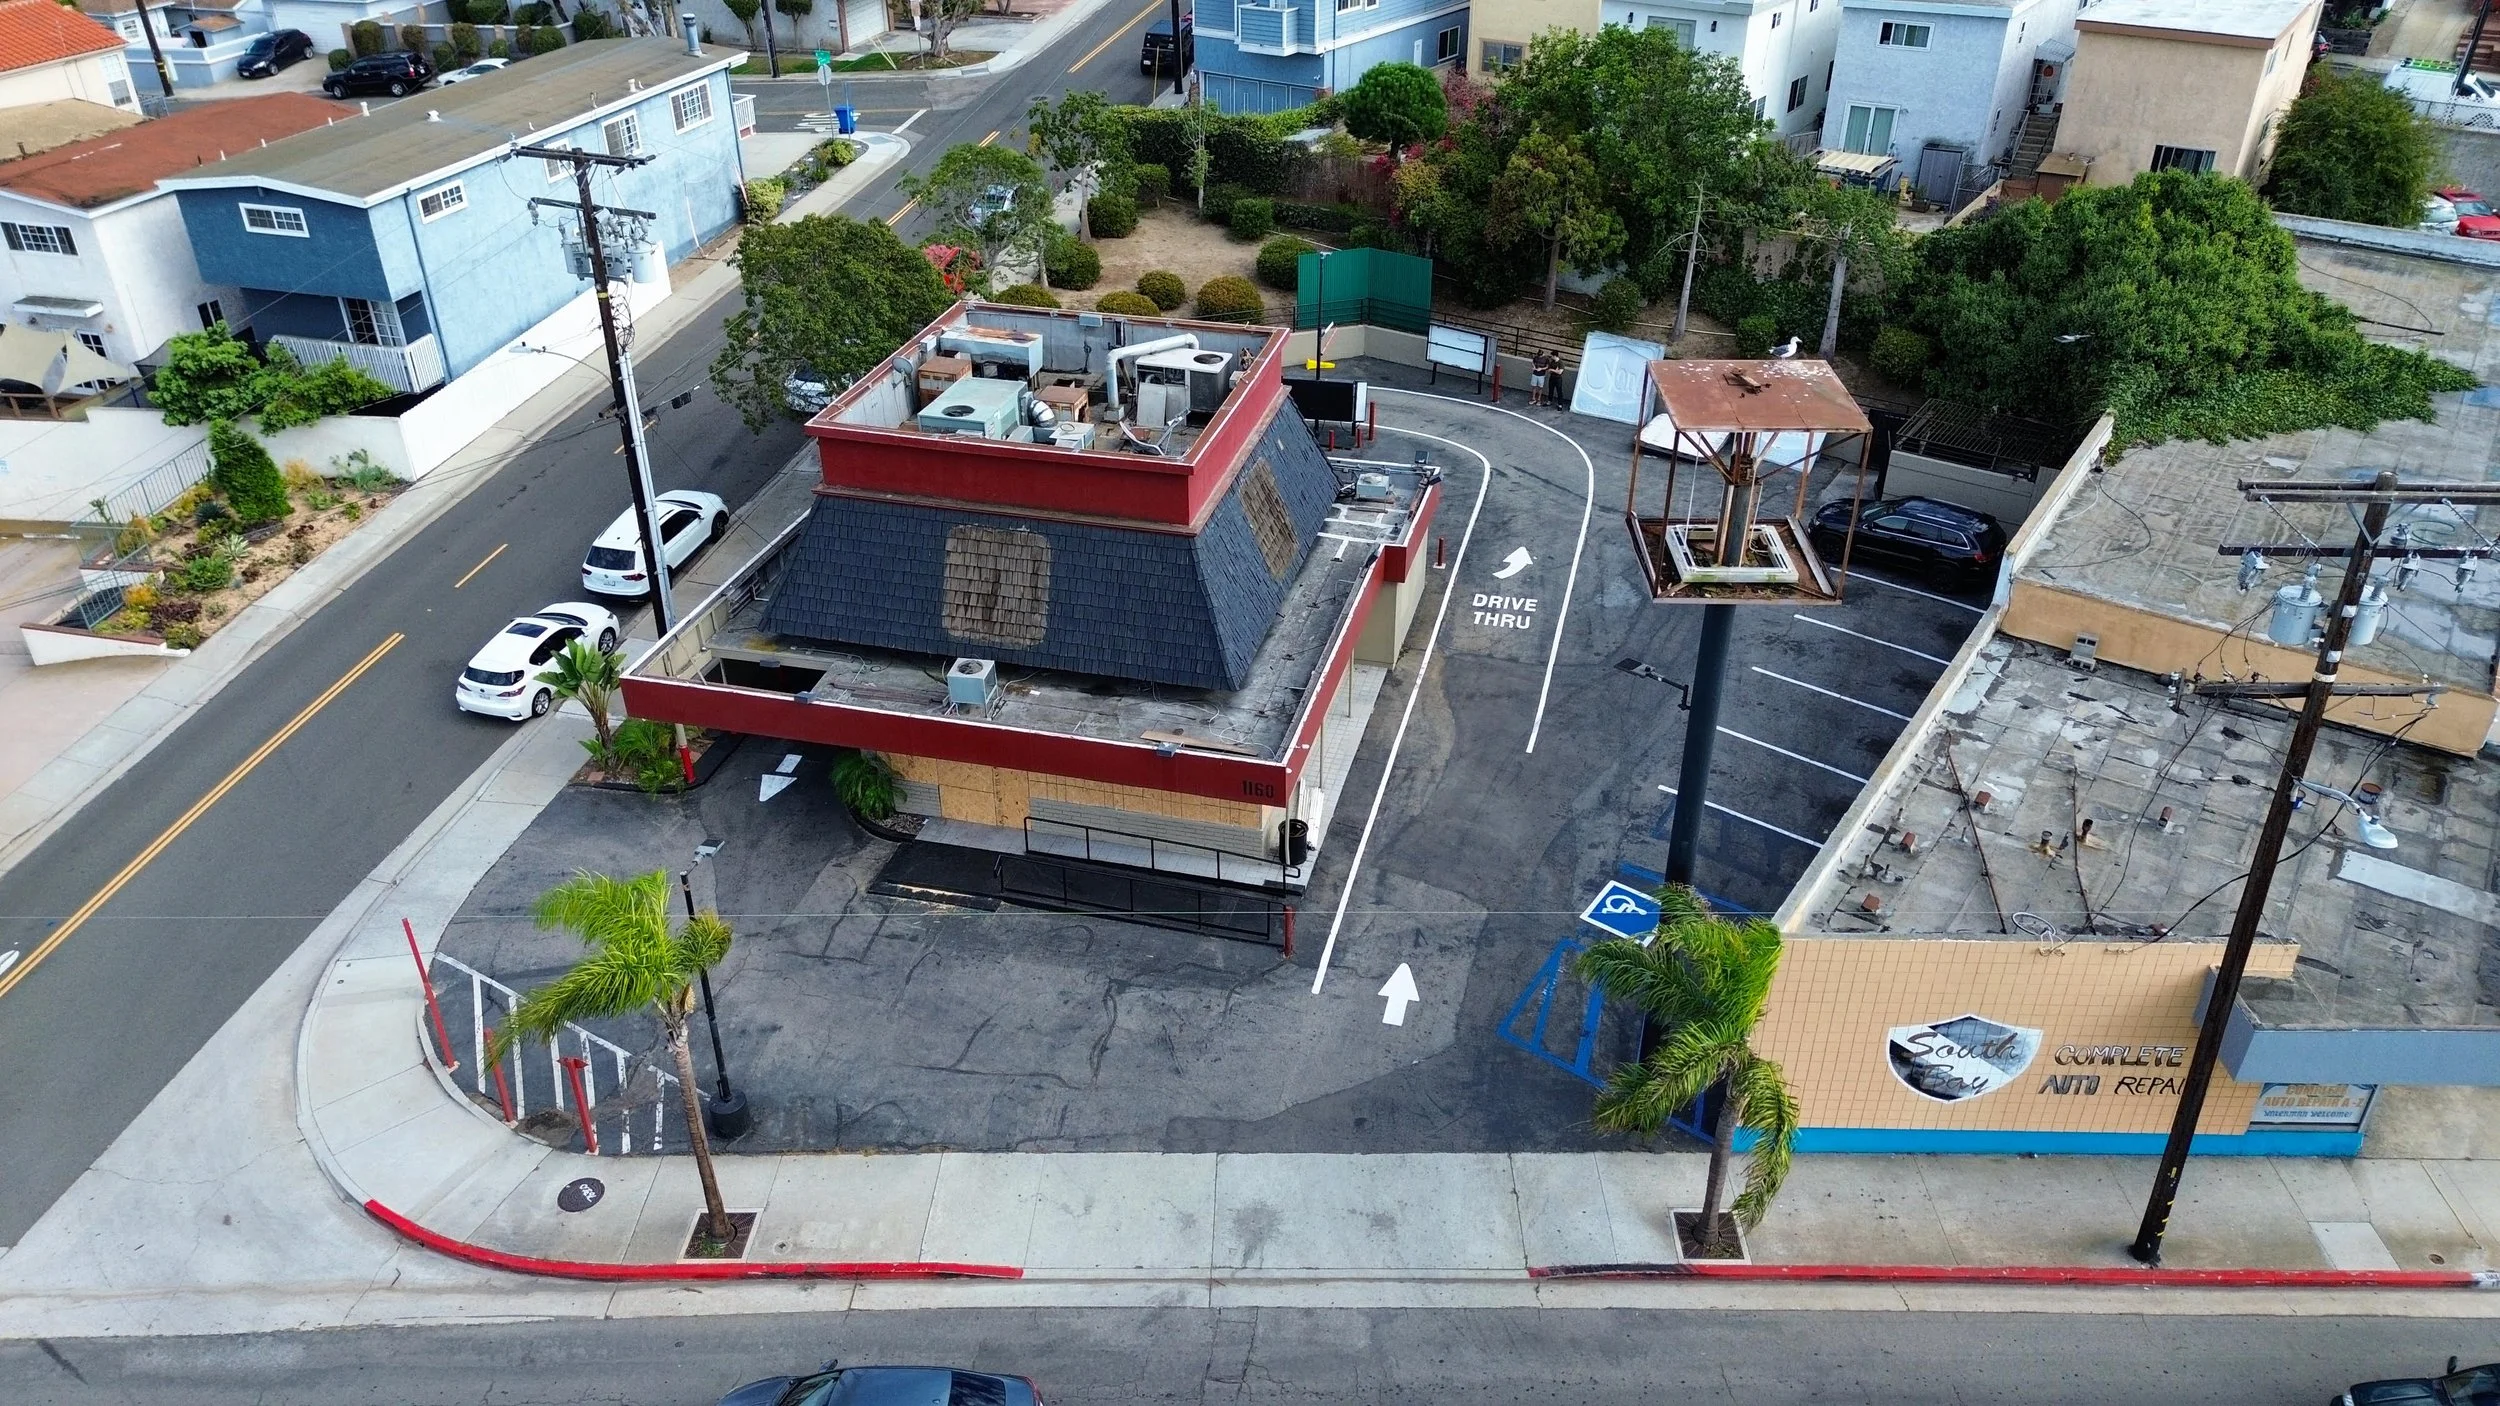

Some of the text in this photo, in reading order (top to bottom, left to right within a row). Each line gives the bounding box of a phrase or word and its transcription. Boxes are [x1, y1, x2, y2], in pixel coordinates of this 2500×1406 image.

[1472, 593, 1538, 612] DRIVE
[1473, 611, 1531, 629] THRU
[1242, 780, 1275, 799] 1160
[1901, 1031, 2018, 1059] South
[2055, 1045, 2188, 1067] COMPLETE
[1920, 1064, 1988, 1095] Bay
[2038, 1075, 2100, 1095] AUTO
[2113, 1076, 2186, 1095] REPAI
[2263, 1096, 2296, 1108] AUTO
[2296, 1097, 2340, 1108] REPAIR
